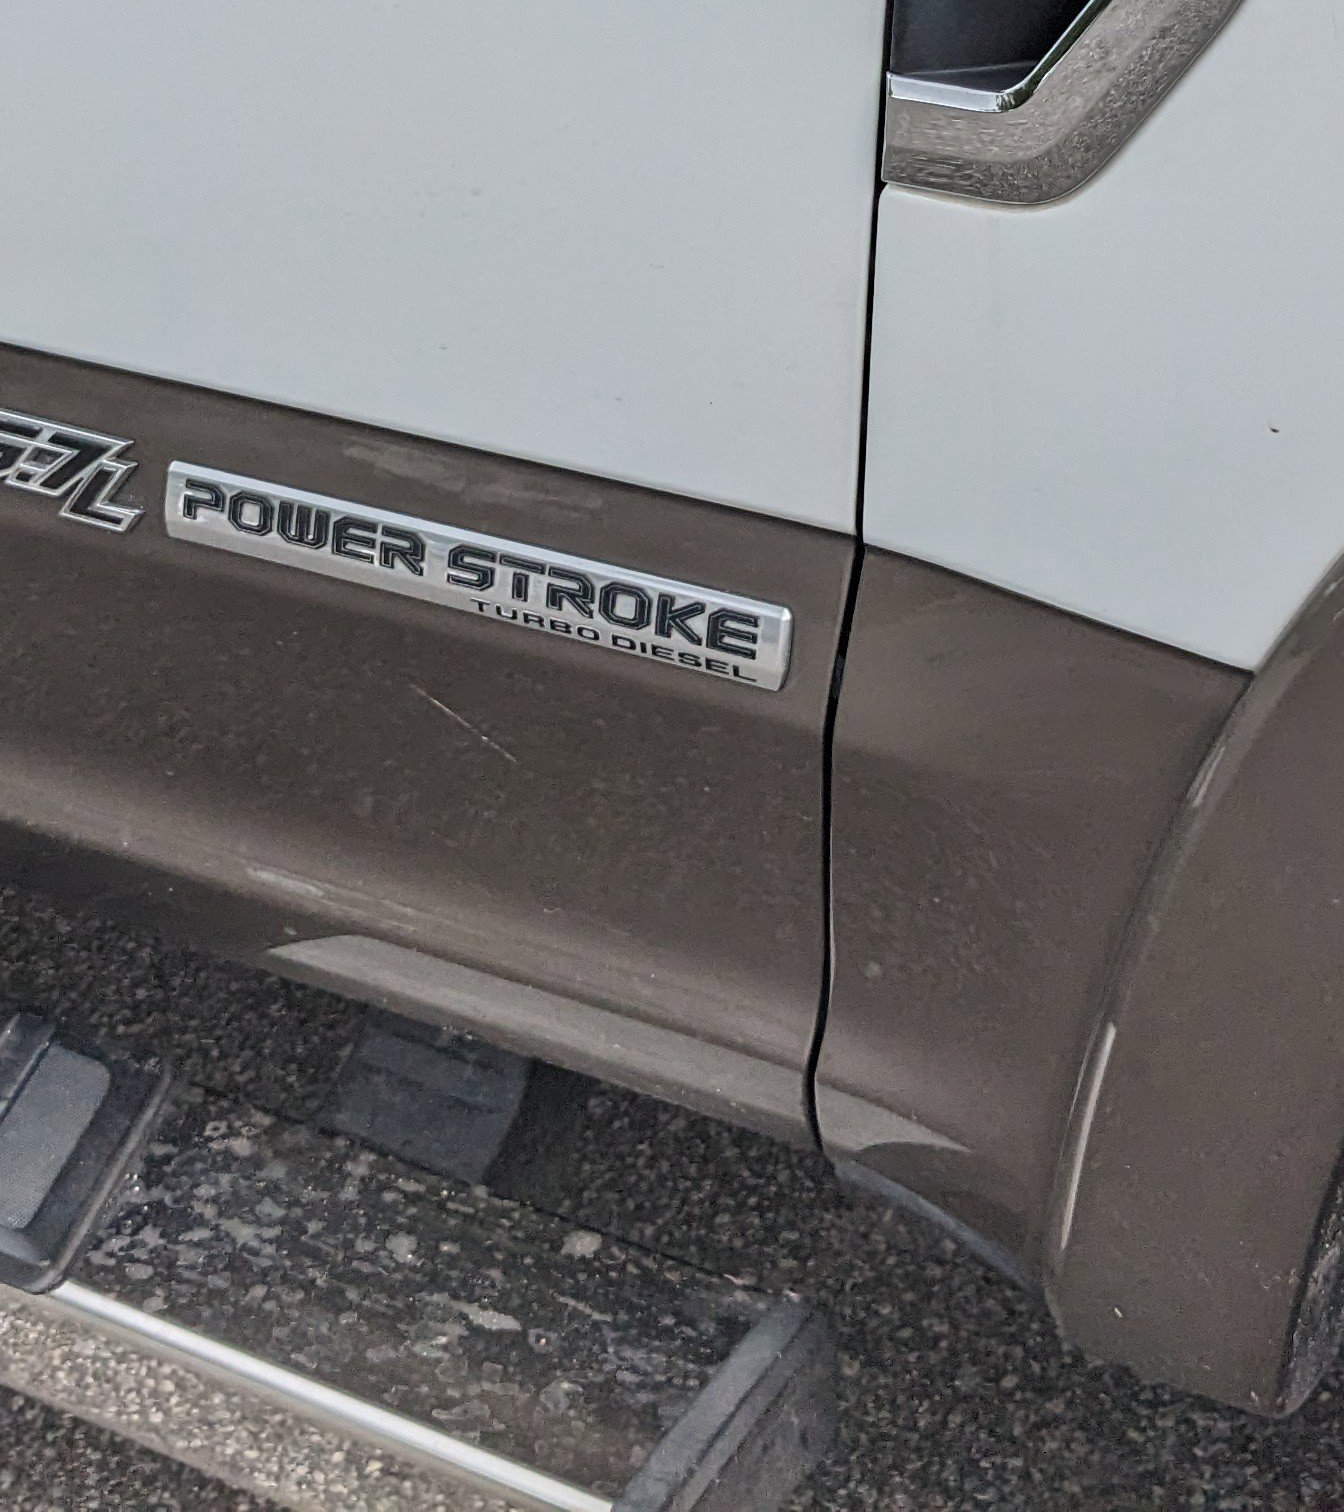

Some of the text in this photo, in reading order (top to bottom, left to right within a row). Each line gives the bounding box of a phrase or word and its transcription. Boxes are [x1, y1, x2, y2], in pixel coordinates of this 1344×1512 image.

[182, 477, 760, 660] POWER STROKE
[470, 597, 758, 683] TURBO DIESEL
